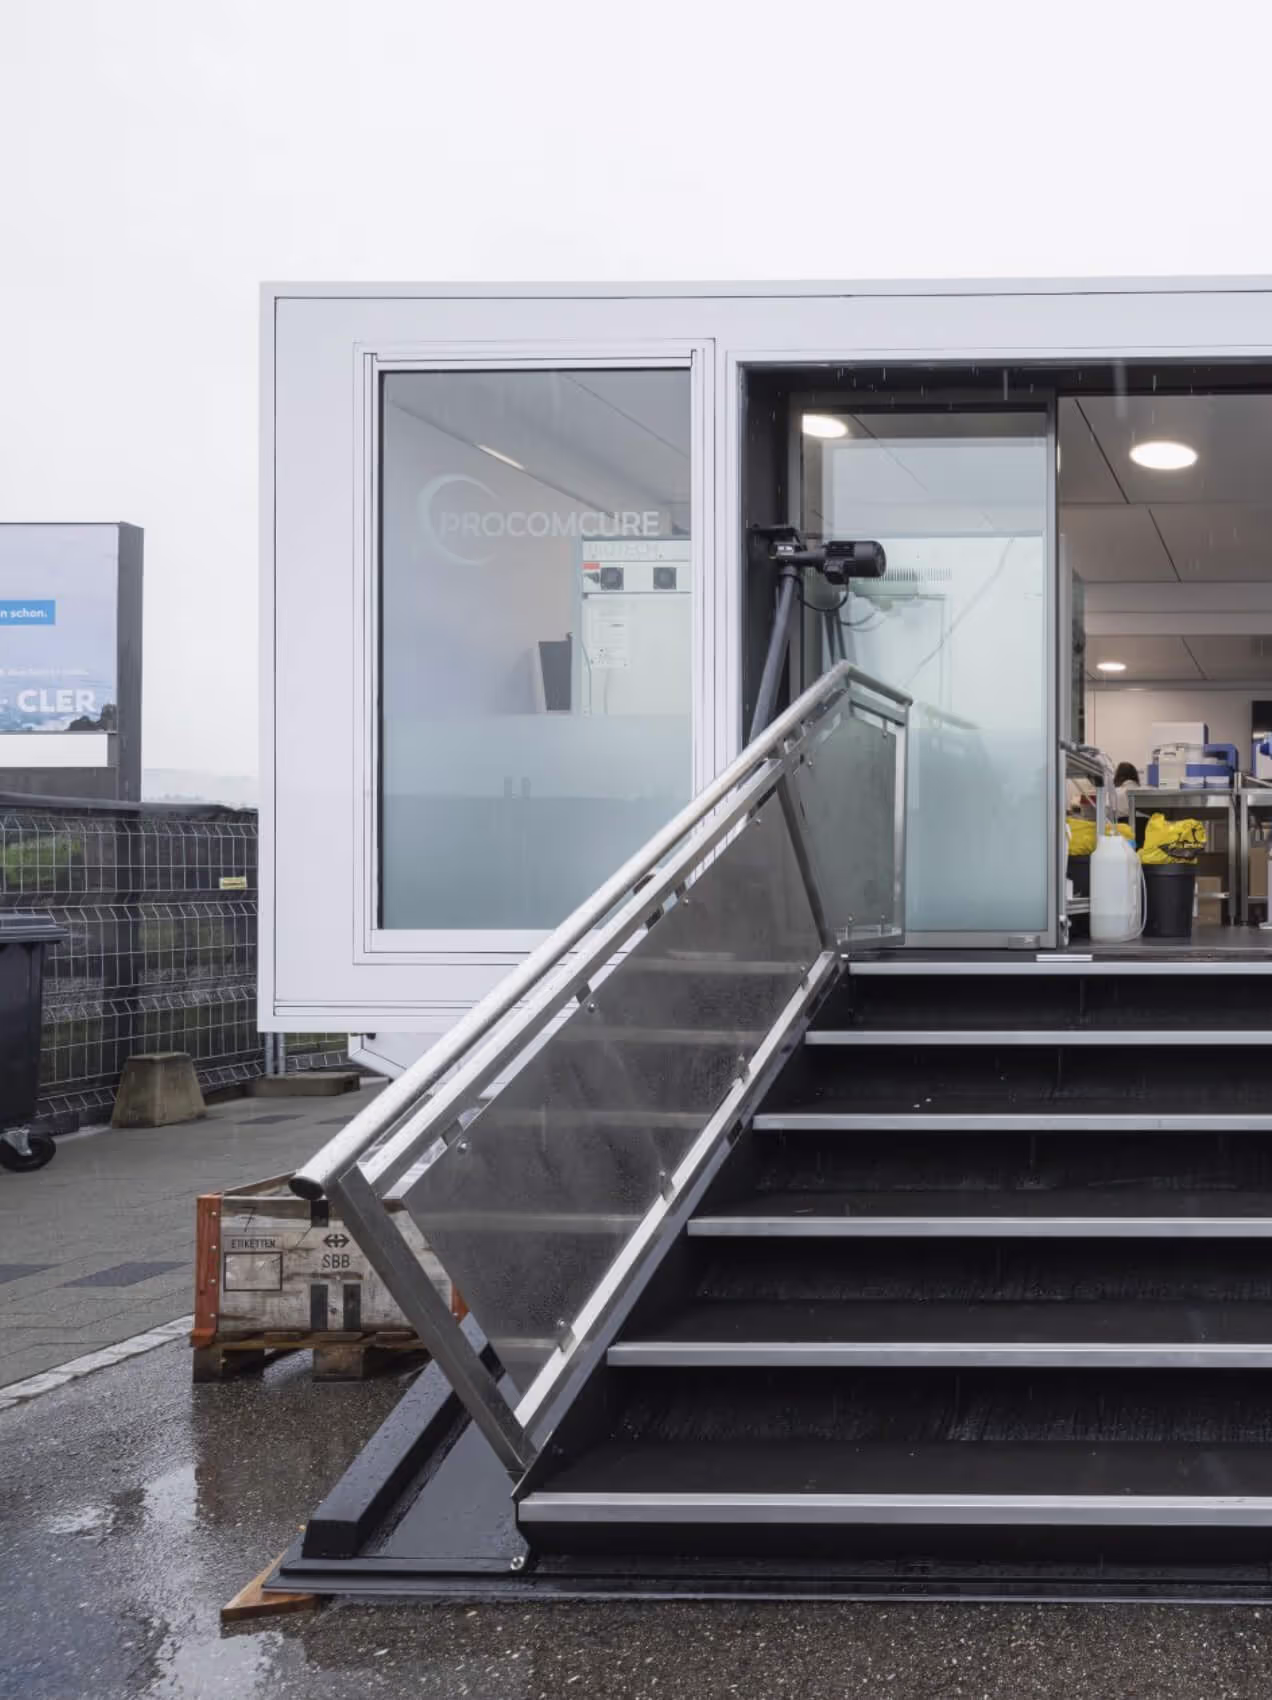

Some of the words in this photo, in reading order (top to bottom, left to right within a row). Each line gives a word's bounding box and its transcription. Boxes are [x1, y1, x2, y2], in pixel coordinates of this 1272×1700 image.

[439, 511, 660, 536] PROCOMCURE
[17, 689, 97, 713] CLER
[231, 1239, 276, 1249] ETIKETTEN
[322, 1254, 351, 1269] SBB
